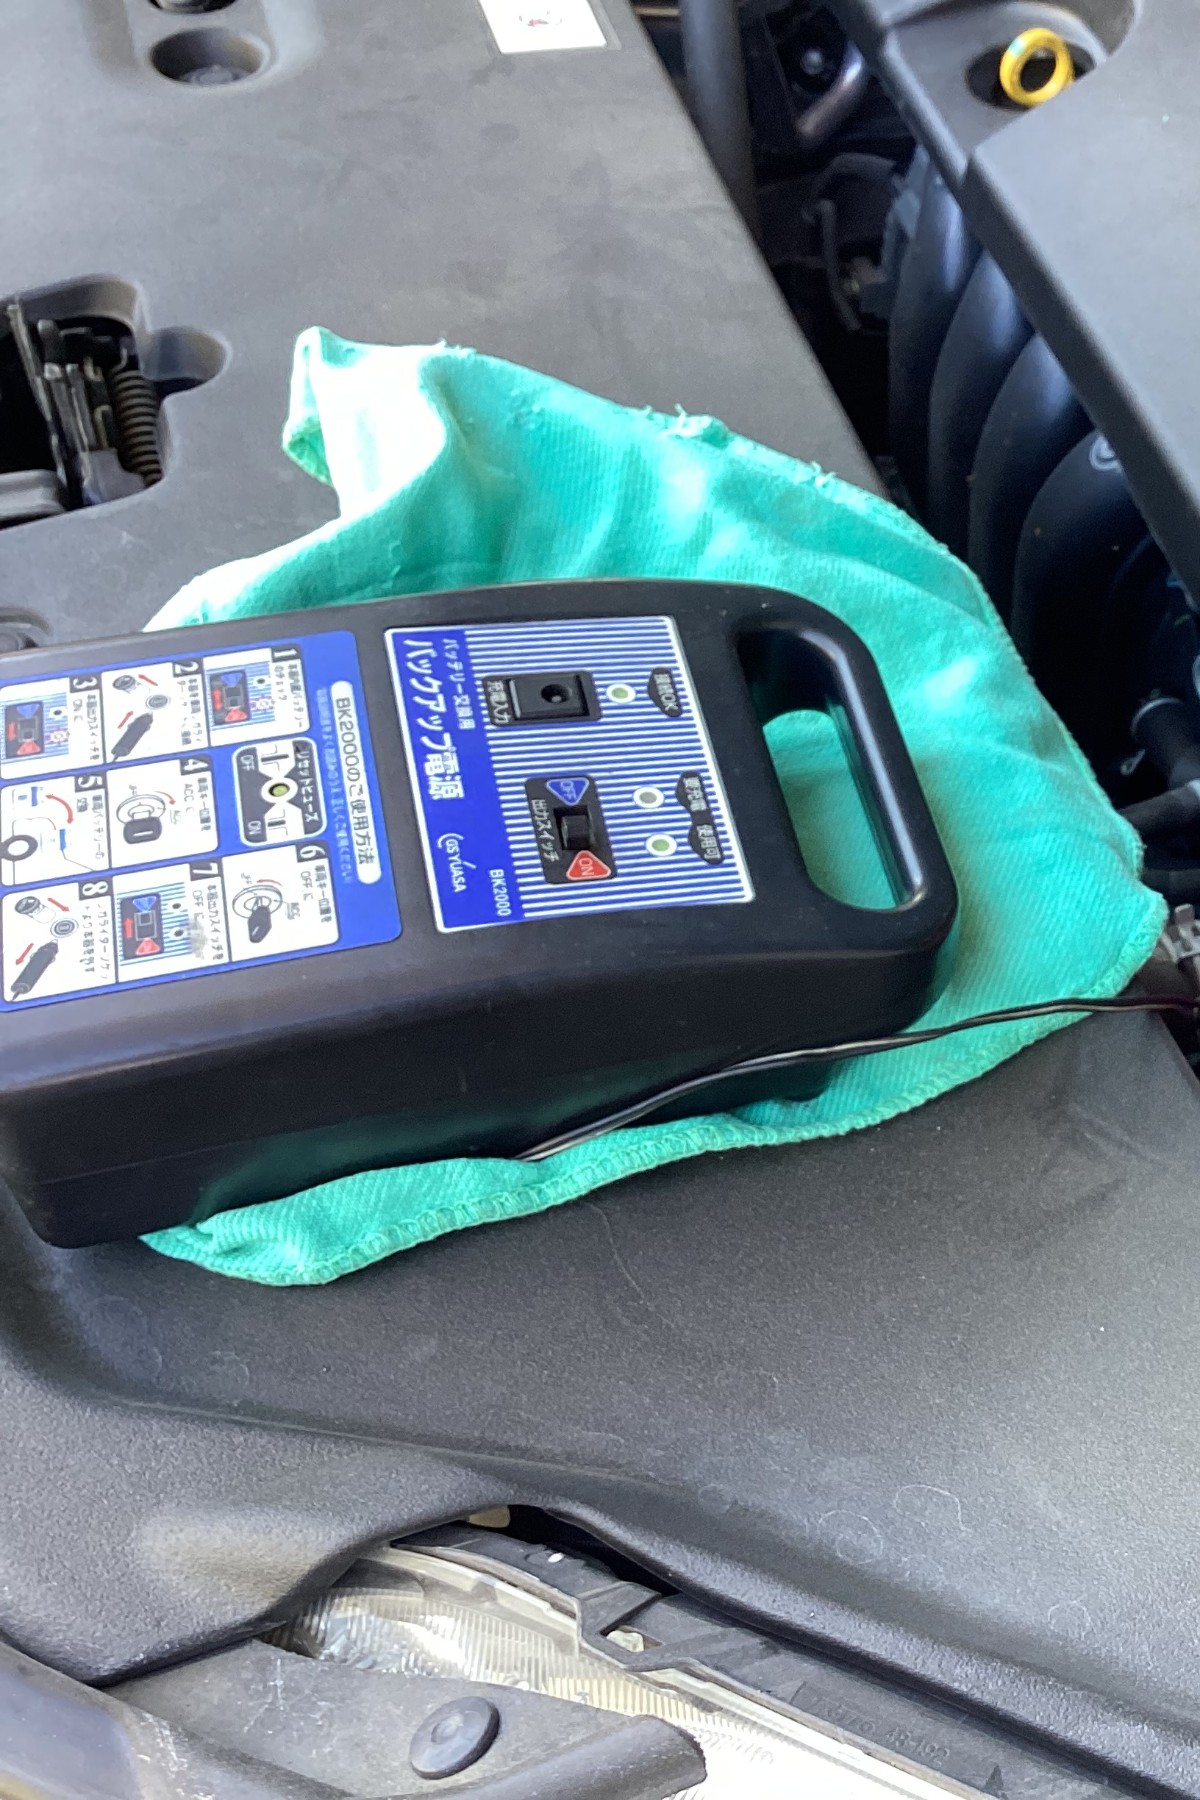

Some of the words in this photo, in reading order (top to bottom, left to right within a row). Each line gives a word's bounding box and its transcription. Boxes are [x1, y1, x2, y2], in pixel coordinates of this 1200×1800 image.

[175, 662, 199, 674] 2
[73, 677, 97, 688] 3
[404, 639, 465, 800] バックアップ電源
[183, 759, 209, 771] 4
[240, 754, 255, 771] OFF
[78, 776, 104, 788] 5
[336, 697, 375, 865] BK2000のご使用方法
[560, 780, 578, 800] OFF
[248, 820, 262, 835] ON
[531, 799, 560, 862] 出力スイッチ
[697, 824, 722, 860] 使用可
[300, 845, 326, 858] 6
[192, 863, 218, 875] 7
[579, 857, 595, 876] ON
[82, 881, 108, 896] 8
[489, 868, 512, 916] BK2000
